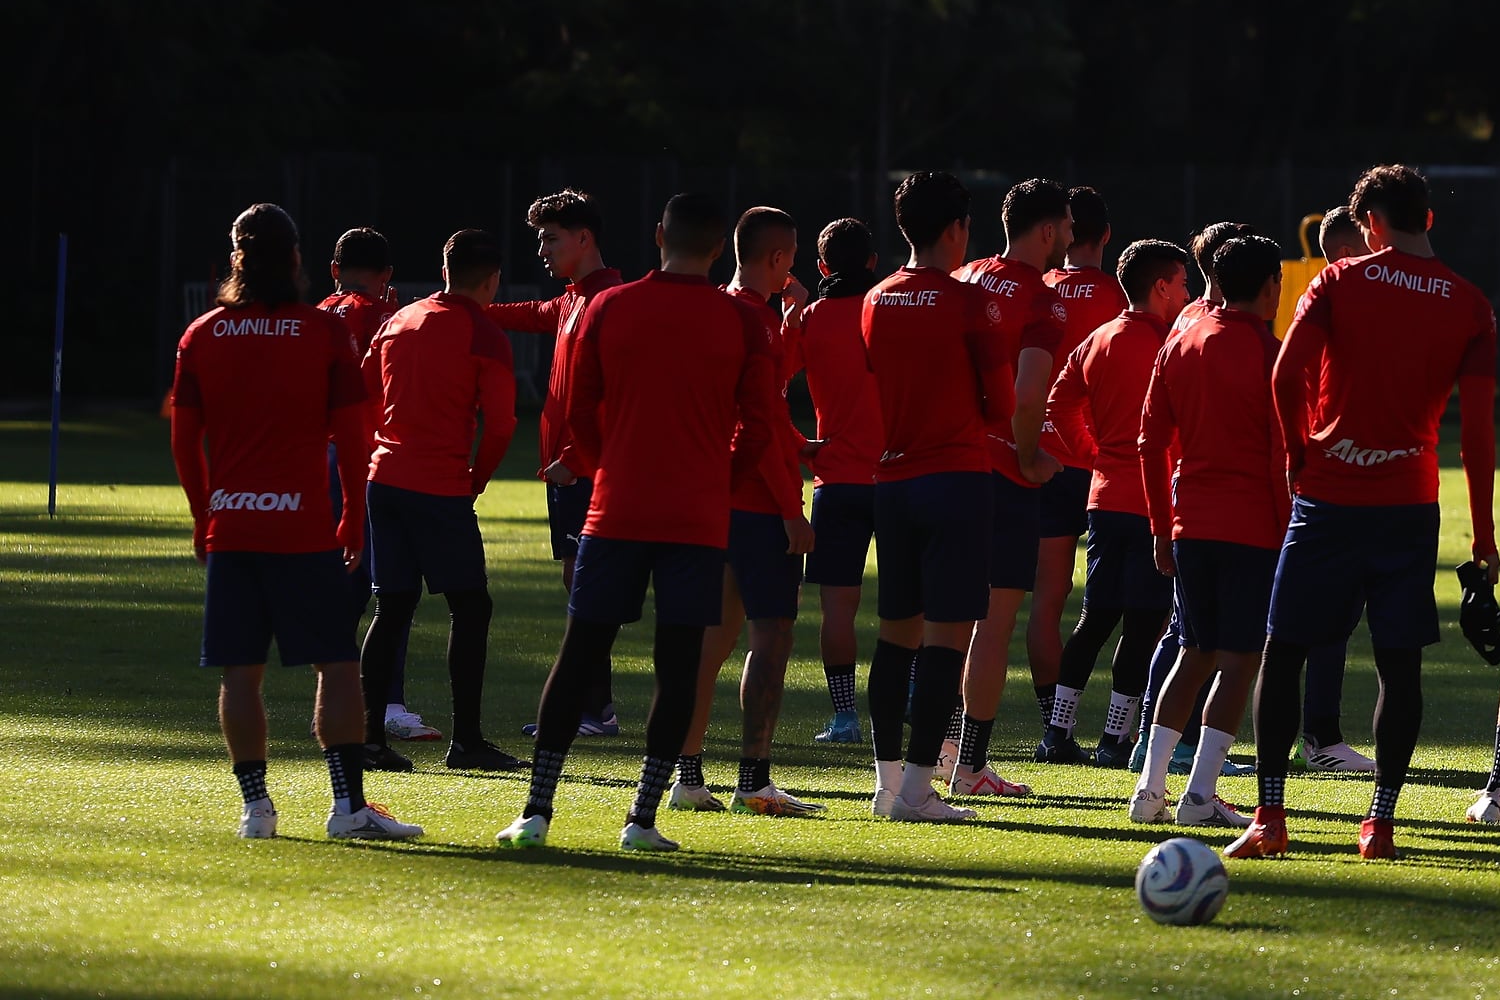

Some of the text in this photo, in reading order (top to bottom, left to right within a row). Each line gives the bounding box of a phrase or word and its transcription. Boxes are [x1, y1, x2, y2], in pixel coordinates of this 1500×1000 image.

[1364, 264, 1452, 299] OMNILIFE
[213, 318, 301, 338] OMNILIFE
[206, 489, 303, 512] AKRON
